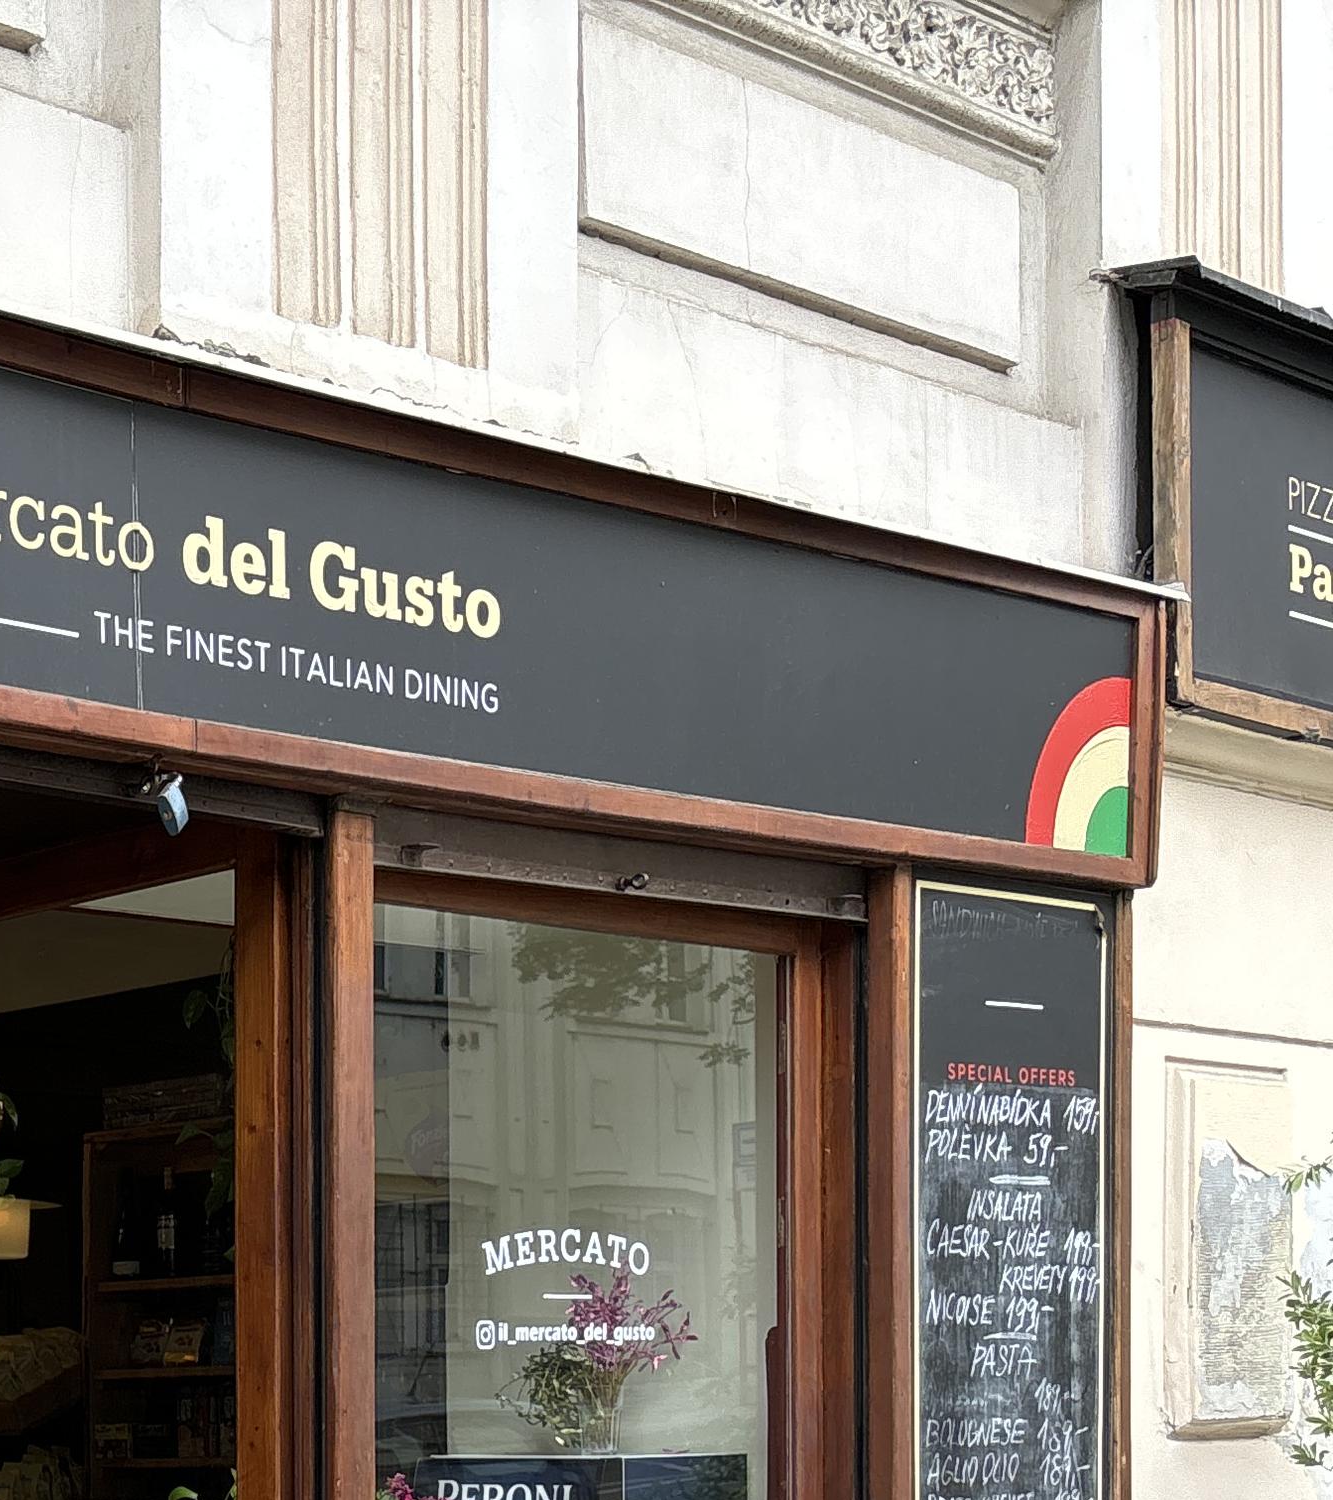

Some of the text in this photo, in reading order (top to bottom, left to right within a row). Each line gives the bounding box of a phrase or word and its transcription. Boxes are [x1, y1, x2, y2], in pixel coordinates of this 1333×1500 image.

[182, 515, 291, 599] del
[309, 541, 501, 638] Gusto
[93, 611, 499, 714] THE FINEST ITALIAN DINING
[947, 1062, 1076, 1087] SPECIAL OFFERS
[966, 1187, 1043, 1222] INSALATA
[481, 1228, 651, 1276] MERCATO
[999, 1263, 1068, 1295] KREVETY
[926, 1287, 996, 1326] NICOISE
[970, 1342, 1039, 1380] PASTA
[926, 1452, 979, 1491] AGLIO
